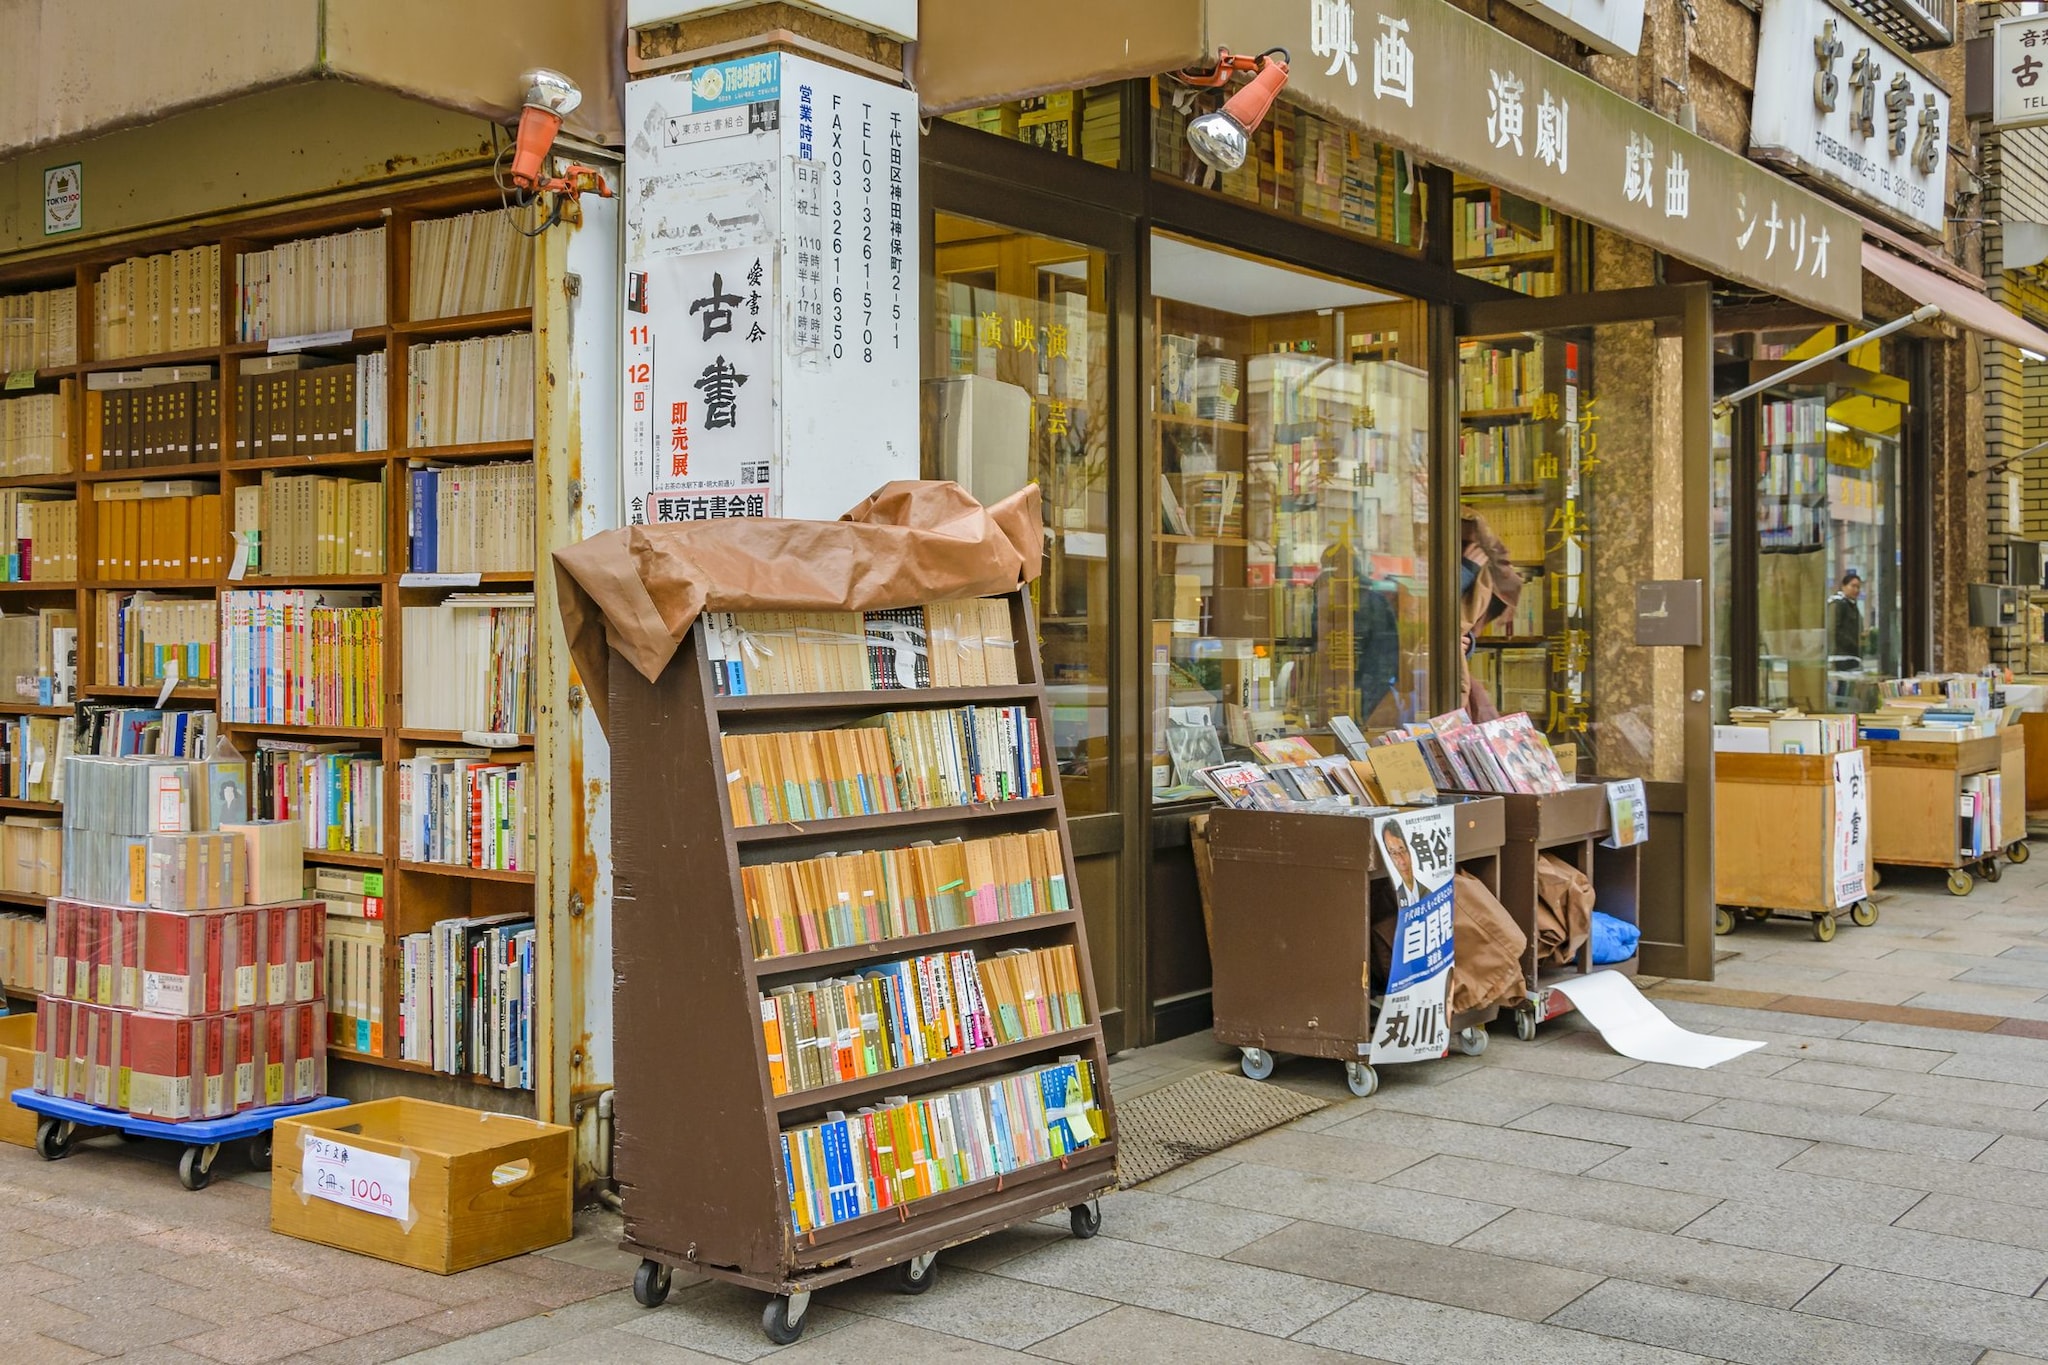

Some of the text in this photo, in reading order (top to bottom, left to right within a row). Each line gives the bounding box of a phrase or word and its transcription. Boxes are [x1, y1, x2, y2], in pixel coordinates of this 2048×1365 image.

[2011, 54, 2043, 88] 古
[682, 110, 777, 136] 東京古書組合 加盟店
[799, 84, 813, 162] 営業時間
[47, 194, 80, 206] TOKYO 100
[1487, 68, 1569, 175] 演劇
[1623, 129, 1690, 219] 戯曲
[1736, 193, 1831, 279] シナリオ
[744, 257, 767, 344] 愛書会
[630, 325, 649, 345] 11
[689, 271, 751, 432] 古書
[628, 363, 650, 384] 12
[1047, 322, 1069, 437] 演芸
[671, 401, 689, 478] 即売展
[657, 494, 764, 523] 東京古書会館
[1546, 505, 1590, 733] 矢口書店
[1410, 828, 1449, 872] 角谷
[1403, 901, 1454, 965] 自民党
[1379, 1005, 1437, 1049] 丸川
